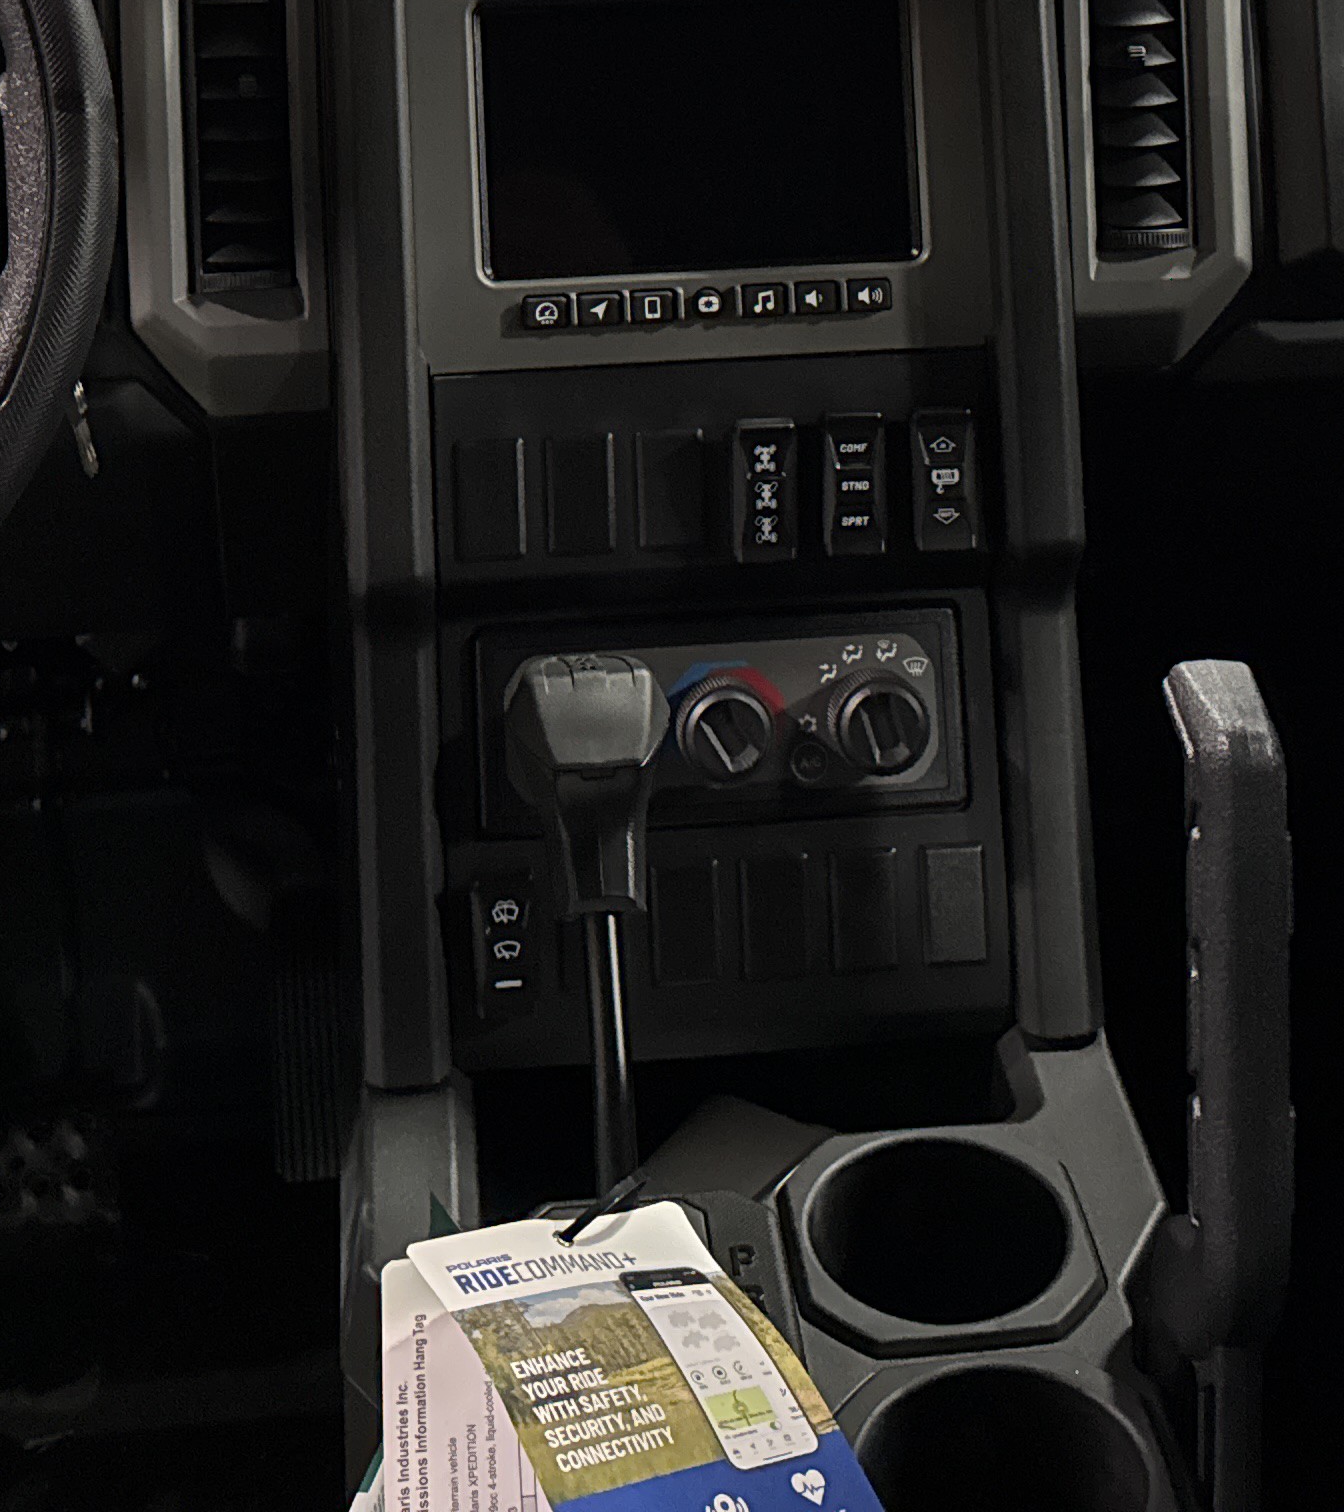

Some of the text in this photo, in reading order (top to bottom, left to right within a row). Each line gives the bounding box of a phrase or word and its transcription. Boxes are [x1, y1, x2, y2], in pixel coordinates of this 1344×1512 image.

[839, 442, 869, 453] COMF
[841, 515, 870, 526] SPRT
[445, 1253, 513, 1273] POLARIS
[453, 1251, 637, 1295] RIDECOMMAND+
[728, 1243, 756, 1277] P
[510, 1347, 592, 1379] ENHANCE
[522, 1367, 609, 1402] YOUR RIDE
[412, 1314, 429, 1512] issions Information Hang Tag
[532, 1383, 649, 1425] WITH SAFETY,
[396, 1381, 411, 1512] aris Industries Inc.
[544, 1403, 667, 1449] SECURITY, AND
[466, 1423, 480, 1512] laris XPEDITION
[555, 1425, 675, 1473] CONNECTIVITY
[447, 1437, 460, 1512] terrain vehicle
